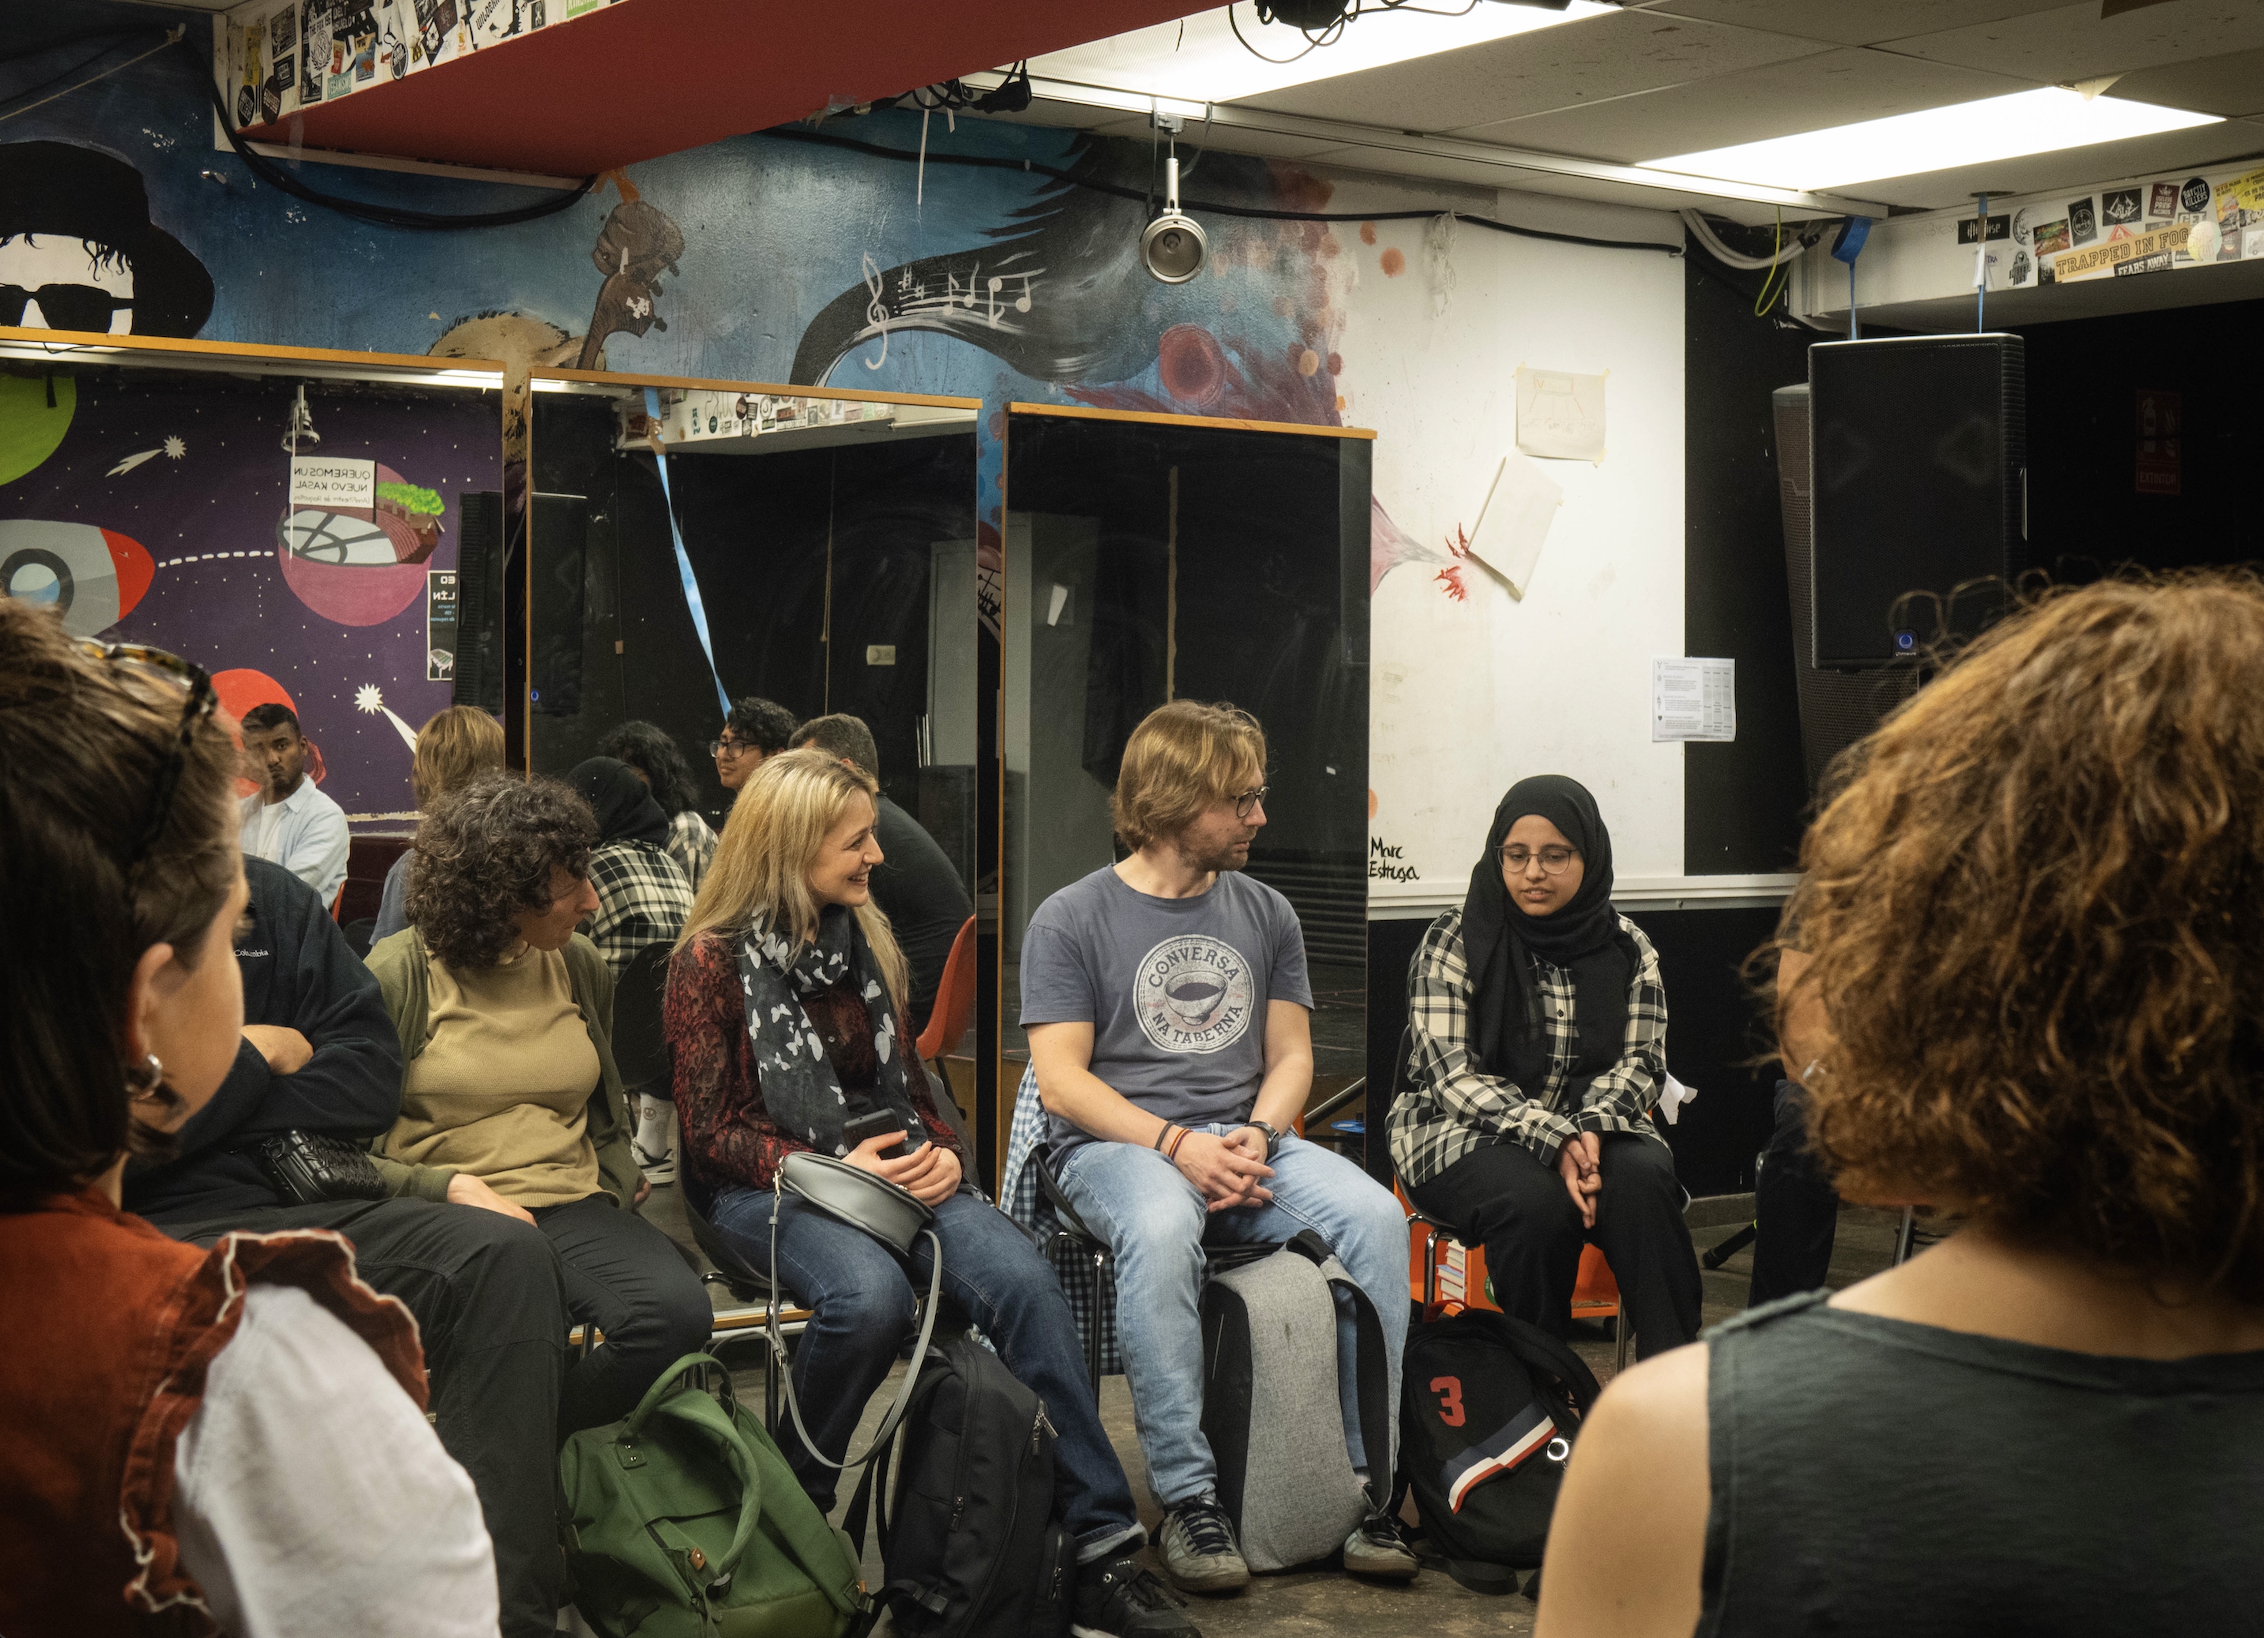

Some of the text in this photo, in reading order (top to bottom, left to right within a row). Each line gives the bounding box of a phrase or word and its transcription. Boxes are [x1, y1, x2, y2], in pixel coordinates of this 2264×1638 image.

[2056, 241, 2130, 276] TRAPPED
[2135, 233, 2154, 256] IN
[2159, 228, 2189, 250] FOG
[2147, 254, 2169, 271] AWAY
[2139, 471, 2177, 485] EXTINTOR
[1148, 946, 1240, 988] CONVERSA
[1152, 1006, 1244, 1044] NA TABERNA
[1429, 1375, 1466, 1428] 3
